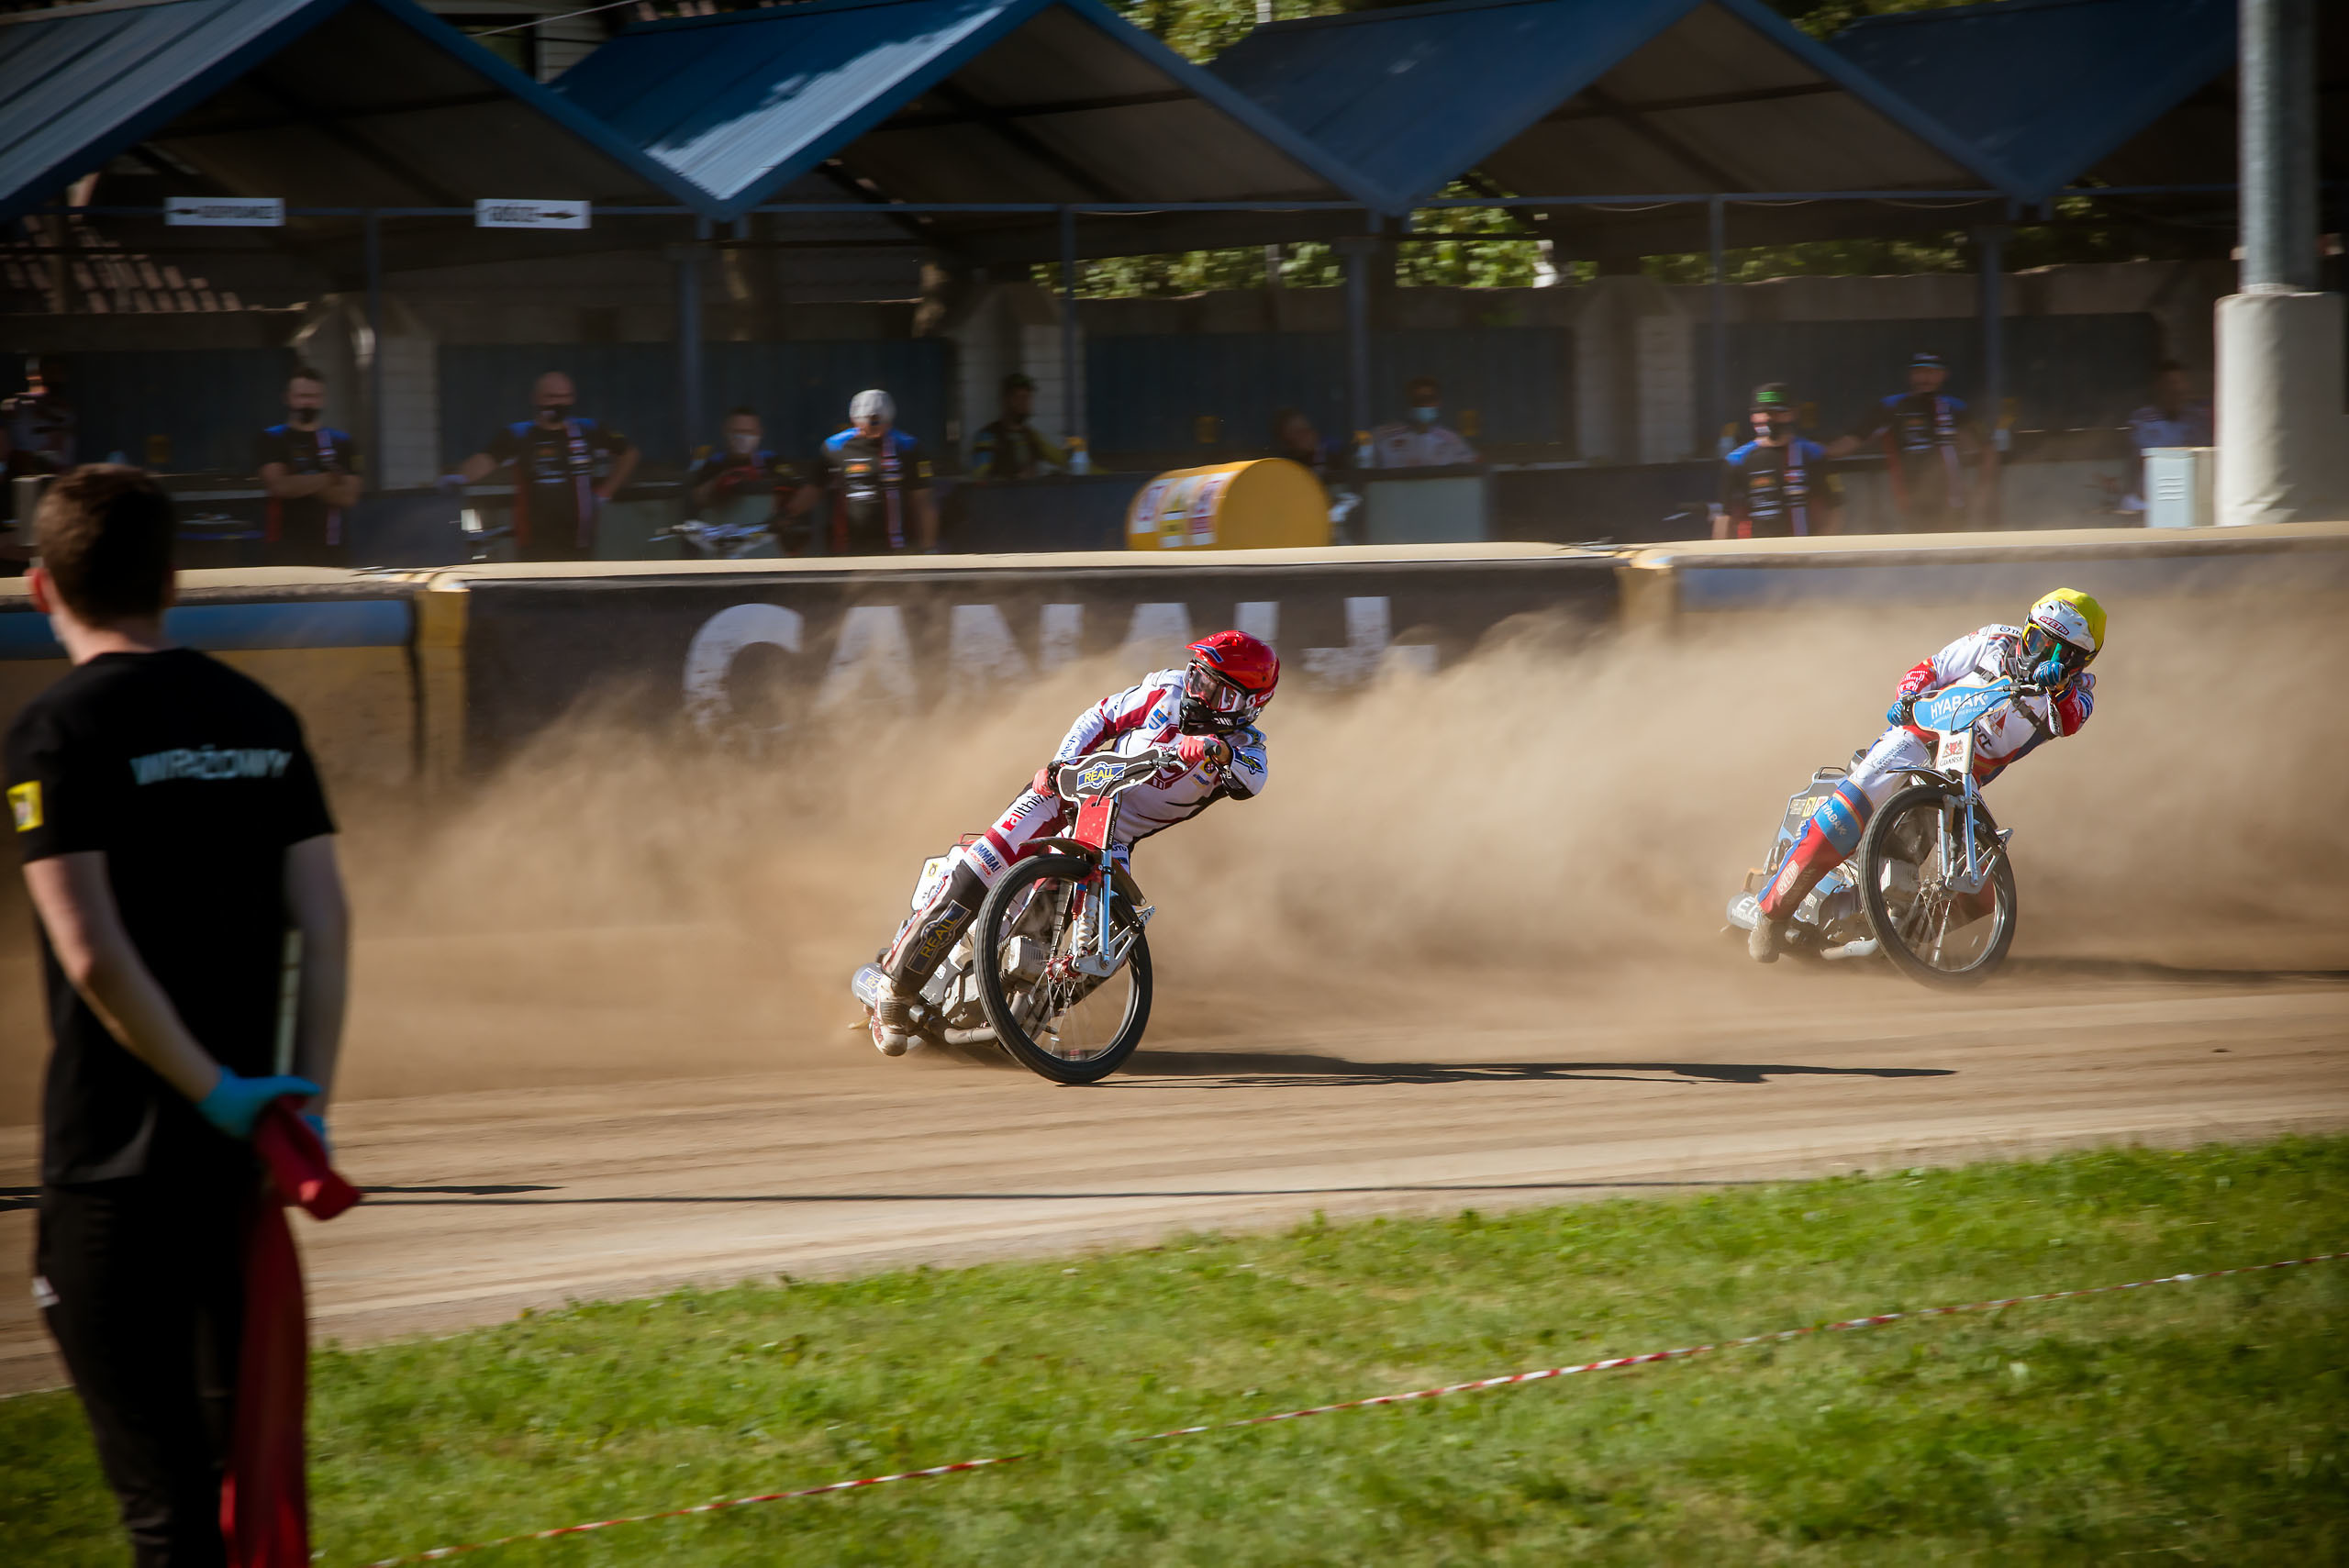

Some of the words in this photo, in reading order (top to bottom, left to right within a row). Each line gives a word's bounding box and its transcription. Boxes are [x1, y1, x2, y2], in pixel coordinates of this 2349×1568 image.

[1930, 691, 1988, 720] HYABAK
[1084, 767, 1115, 784] REALL
[919, 917, 958, 959] REALL
